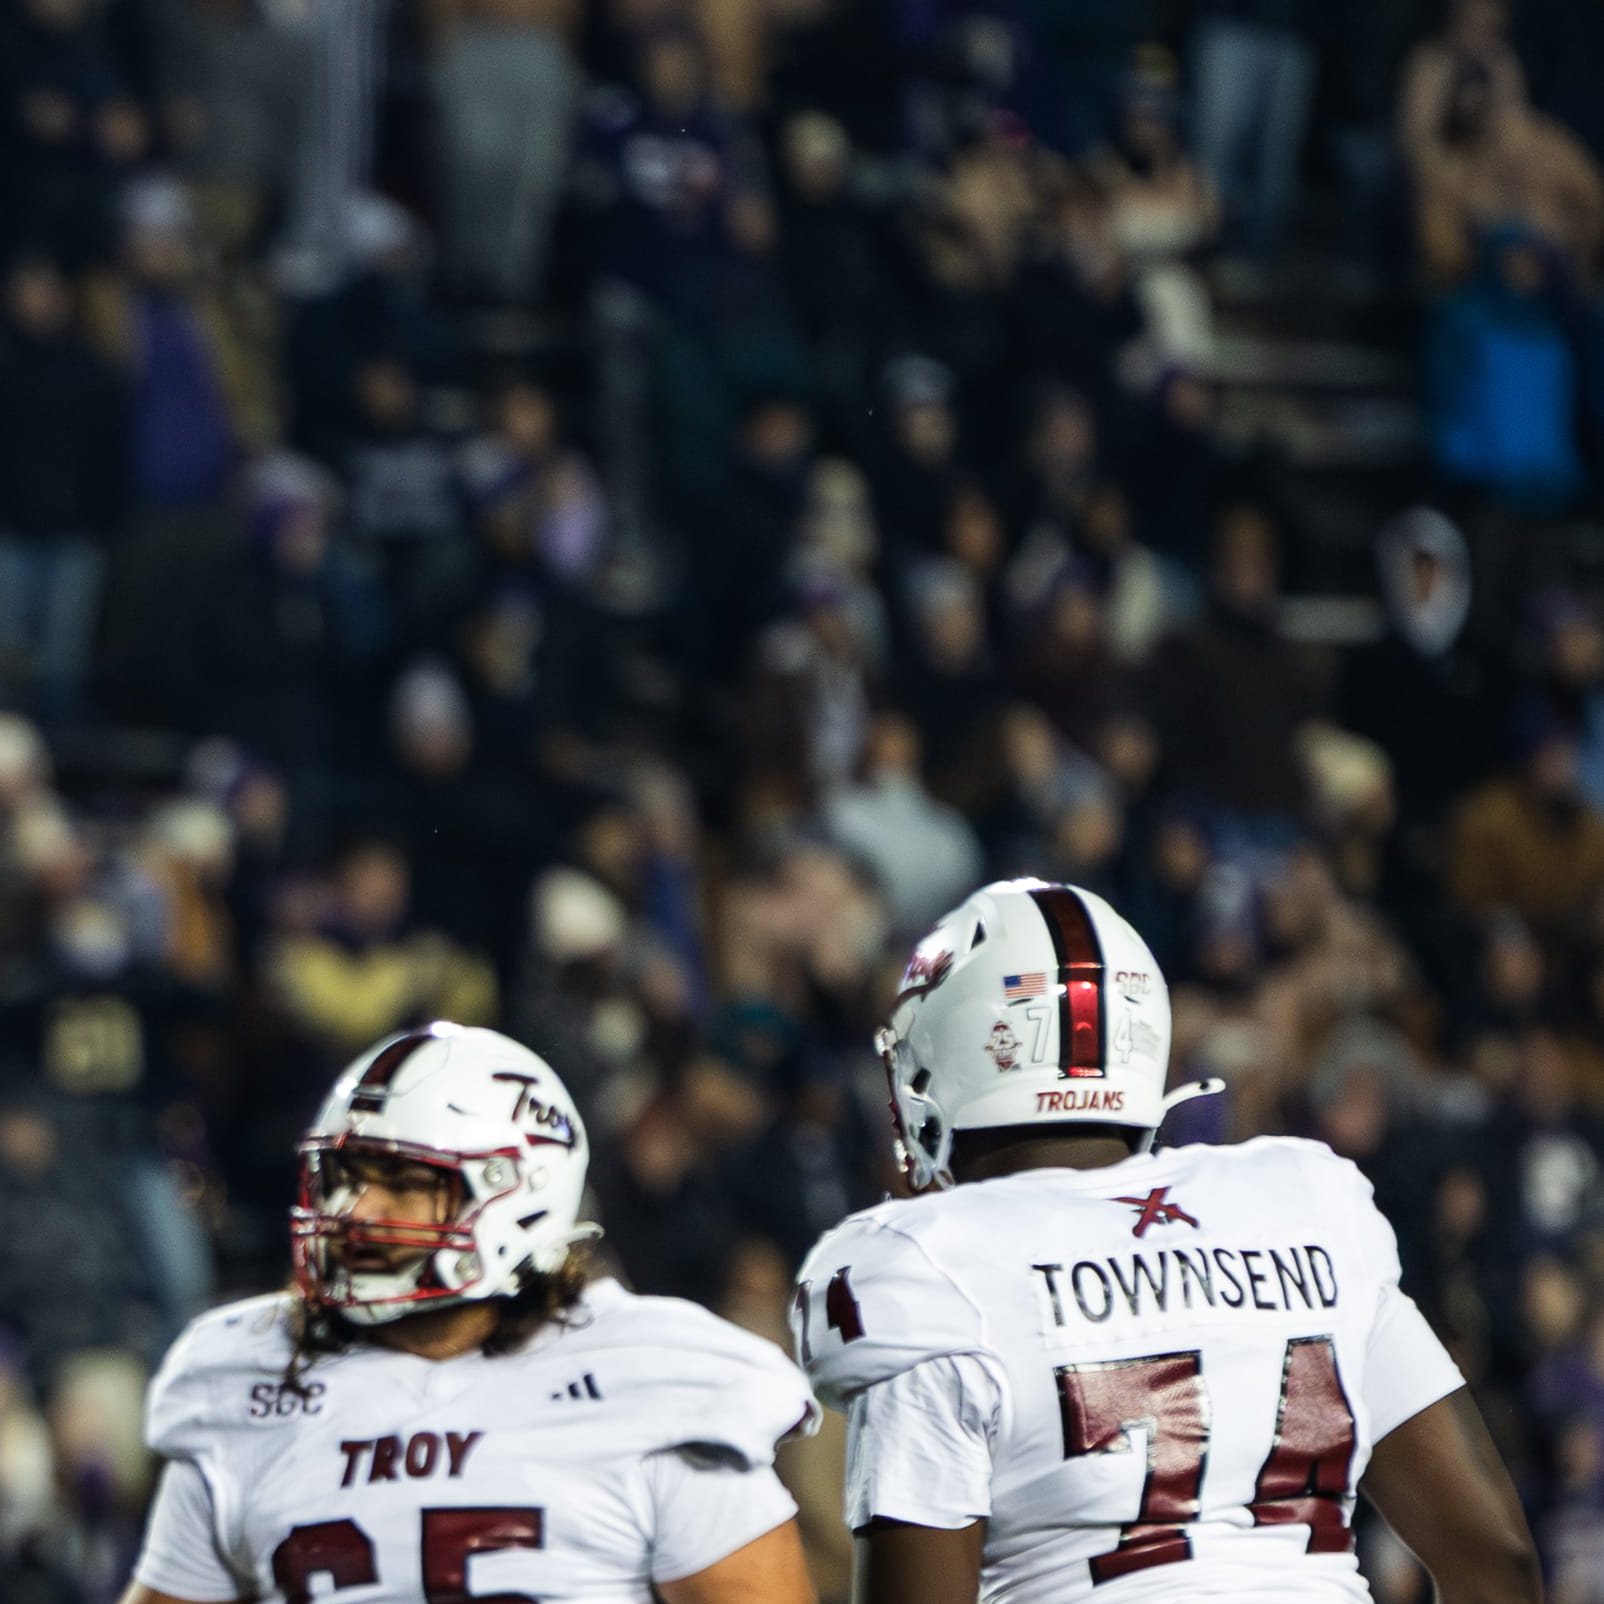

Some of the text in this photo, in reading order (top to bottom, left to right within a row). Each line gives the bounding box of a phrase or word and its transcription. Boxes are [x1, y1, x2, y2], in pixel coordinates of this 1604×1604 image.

[1036, 1089, 1126, 1113] TROJANS
[1032, 1244, 1339, 1327] TOWNSEND
[339, 1430, 486, 1490] TROY
[1052, 1333, 1358, 1588] 74
